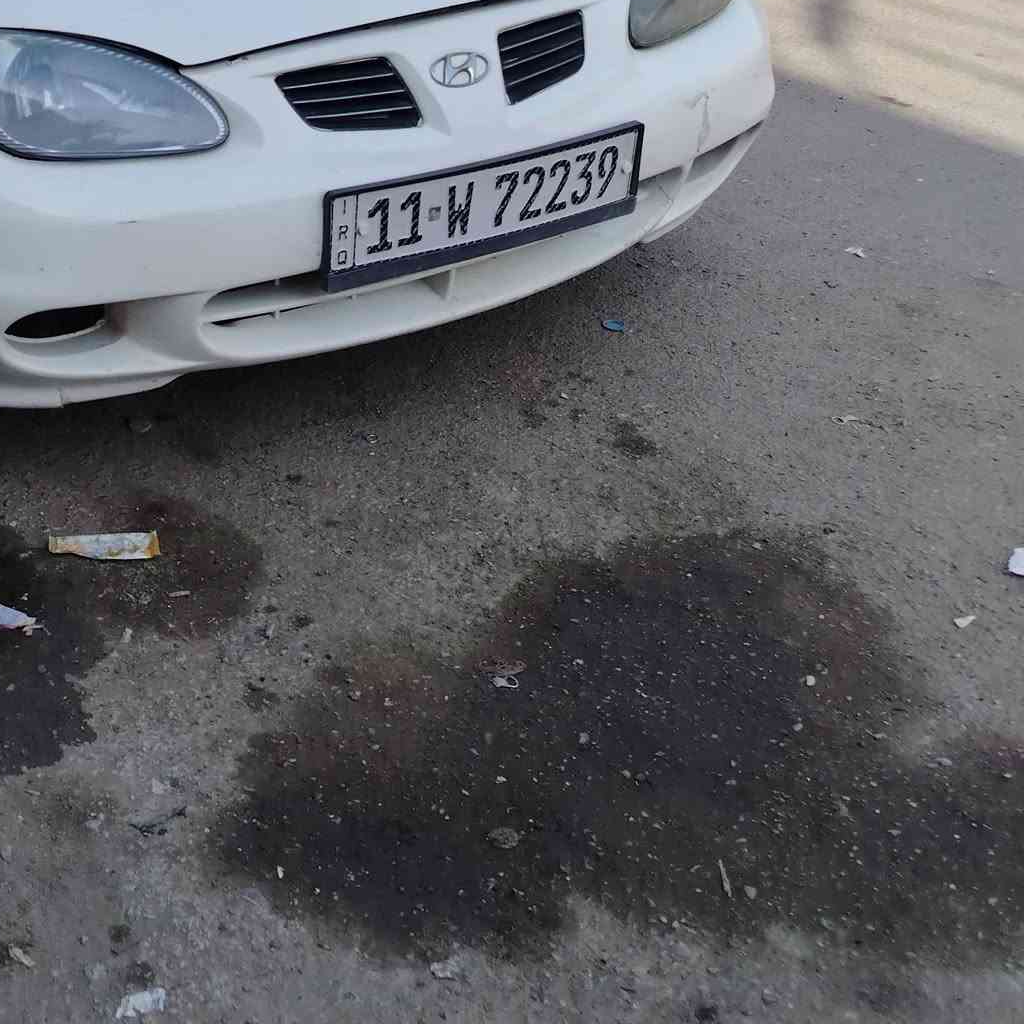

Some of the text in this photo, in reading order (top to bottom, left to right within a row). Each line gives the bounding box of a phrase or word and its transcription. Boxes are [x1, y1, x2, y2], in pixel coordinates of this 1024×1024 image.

[366, 144, 619, 255] 11 W 72239
